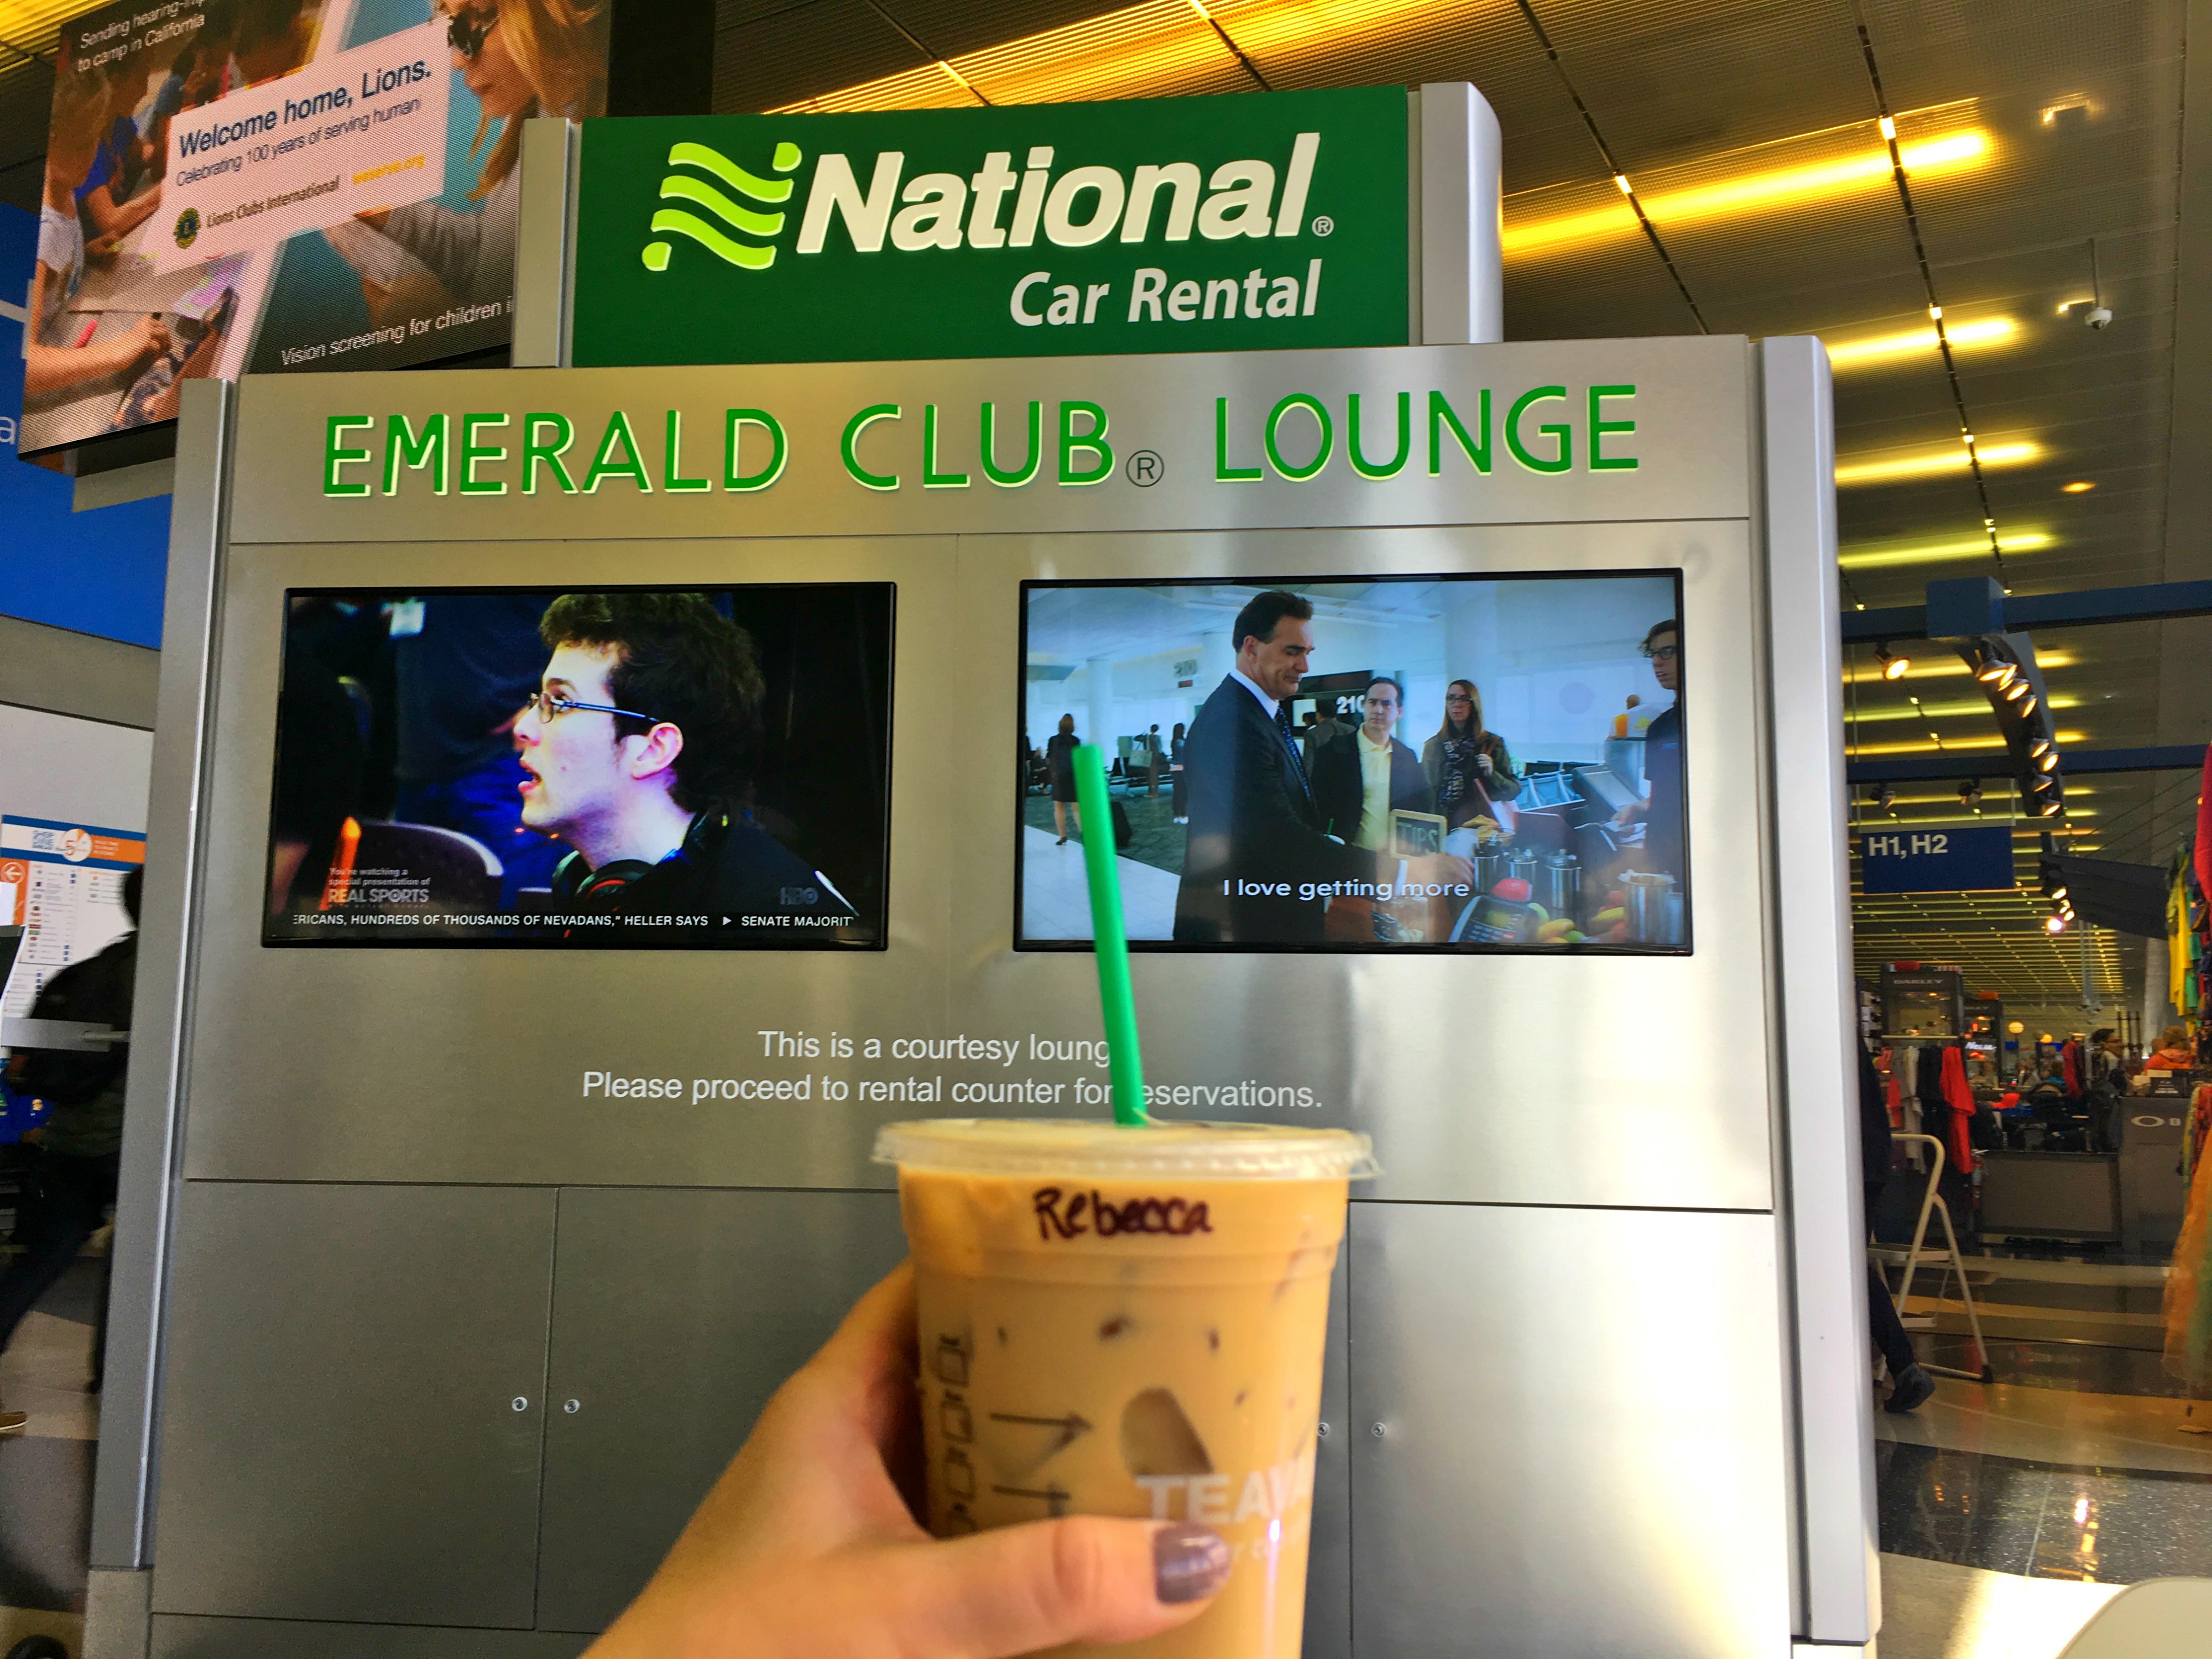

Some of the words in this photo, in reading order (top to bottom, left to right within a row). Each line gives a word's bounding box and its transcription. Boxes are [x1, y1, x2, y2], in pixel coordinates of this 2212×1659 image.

[77, 58, 91, 72] to
[92, 44, 128, 67] camp
[130, 38, 143, 53] in
[144, 14, 206, 46] California
[80, 20, 131, 49] Sending
[179, 111, 278, 159] Welcome
[284, 84, 353, 124] home,
[362, 58, 432, 99] Lions.
[175, 154, 242, 187] Celebrating
[247, 144, 269, 163] 100
[271, 134, 305, 160] years
[309, 127, 323, 145] of
[325, 113, 369, 140] serving
[207, 212, 234, 228] Lions
[236, 199, 265, 220] Clubs
[266, 175, 341, 211] International
[796, 133, 1321, 254] National
[1010, 270, 1109, 327] Car
[1128, 259, 1322, 324] Rental
[281, 343, 326, 365] Vision
[330, 324, 405, 354] screening
[409, 318, 432, 335] for
[435, 300, 502, 330] children
[324, 408, 789, 498] EMERALD
[840, 400, 1116, 491] CLUB
[1215, 384, 1639, 483] LOUNGE
[1869, 836, 1907, 859] H1,
[1911, 834, 1949, 855] H2
[359, 867, 401, 877] watching
[362, 878, 419, 886] presentation
[420, 877, 431, 885] of
[1223, 879, 1230, 896] I
[1238, 879, 1292, 896] love
[1298, 878, 1394, 901] getting
[1400, 882, 1470, 896] more
[328, 888, 367, 903] REAL
[368, 888, 430, 903] SPORTS
[779, 886, 820, 906] HBO
[351, 914, 420, 925] HUNDREDS
[422, 915, 441, 925] OF
[443, 915, 520, 926] THOUSANDS
[524, 915, 542, 926] OF
[624, 915, 673, 926] HELLER
[675, 916, 708, 927] SAYS
[741, 916, 790, 927] SENATE
[794, 916, 854, 927] MAJORIT
[758, 1031, 822, 1059] This
[830, 1031, 854, 1059] is
[863, 1037, 883, 1059] a
[891, 1033, 1022, 1067] courtesy
[1030, 1033, 1110, 1068] loung
[582, 1072, 684, 1099] Please
[692, 1073, 812, 1107] proceed
[821, 1074, 849, 1101] to
[858, 1074, 942, 1102] rental
[951, 1078, 1066, 1104] counter
[1073, 1077, 1113, 1104] for
[1140, 1079, 1323, 1108] eservations.
[1032, 1187, 1214, 1241] Rebecca
